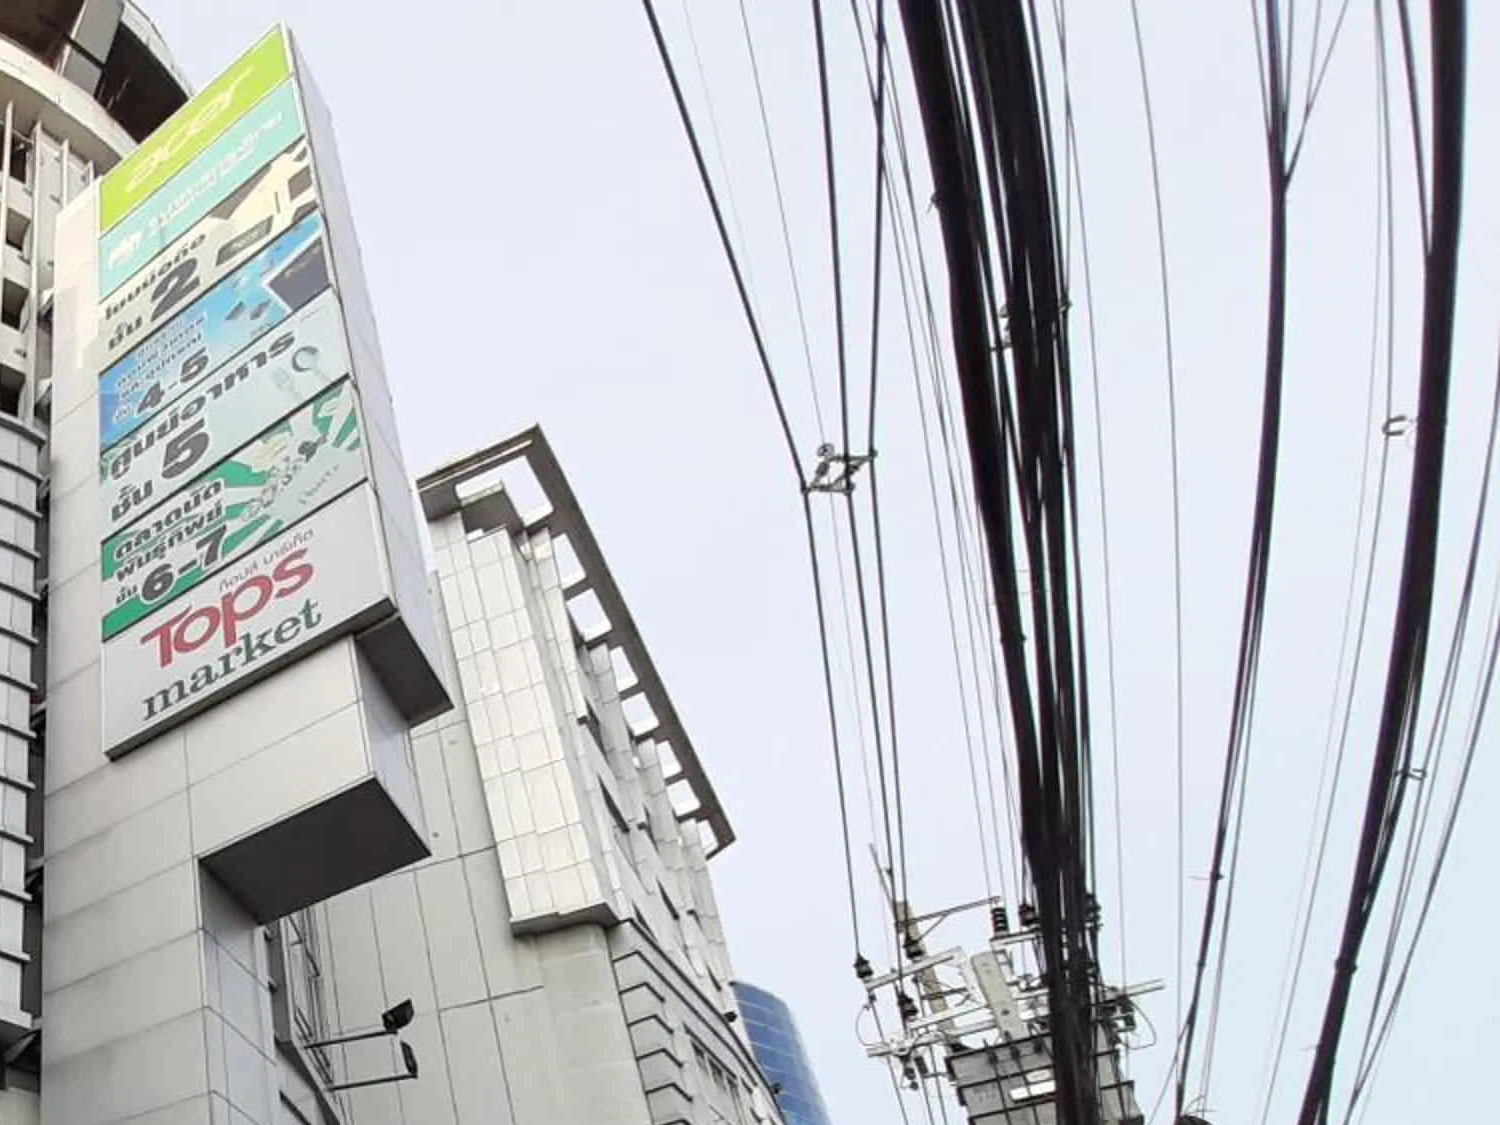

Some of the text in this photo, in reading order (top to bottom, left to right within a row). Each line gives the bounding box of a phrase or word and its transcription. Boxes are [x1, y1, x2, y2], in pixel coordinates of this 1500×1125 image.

[151, 258, 200, 322] 2
[111, 331, 296, 481] ศูนย์อาหาร
[136, 348, 209, 415] 4-5
[111, 417, 210, 522] ชั้น 5
[115, 479, 223, 561] ตลาดนัด
[141, 525, 227, 602] 6-7
[143, 598, 323, 721] market
